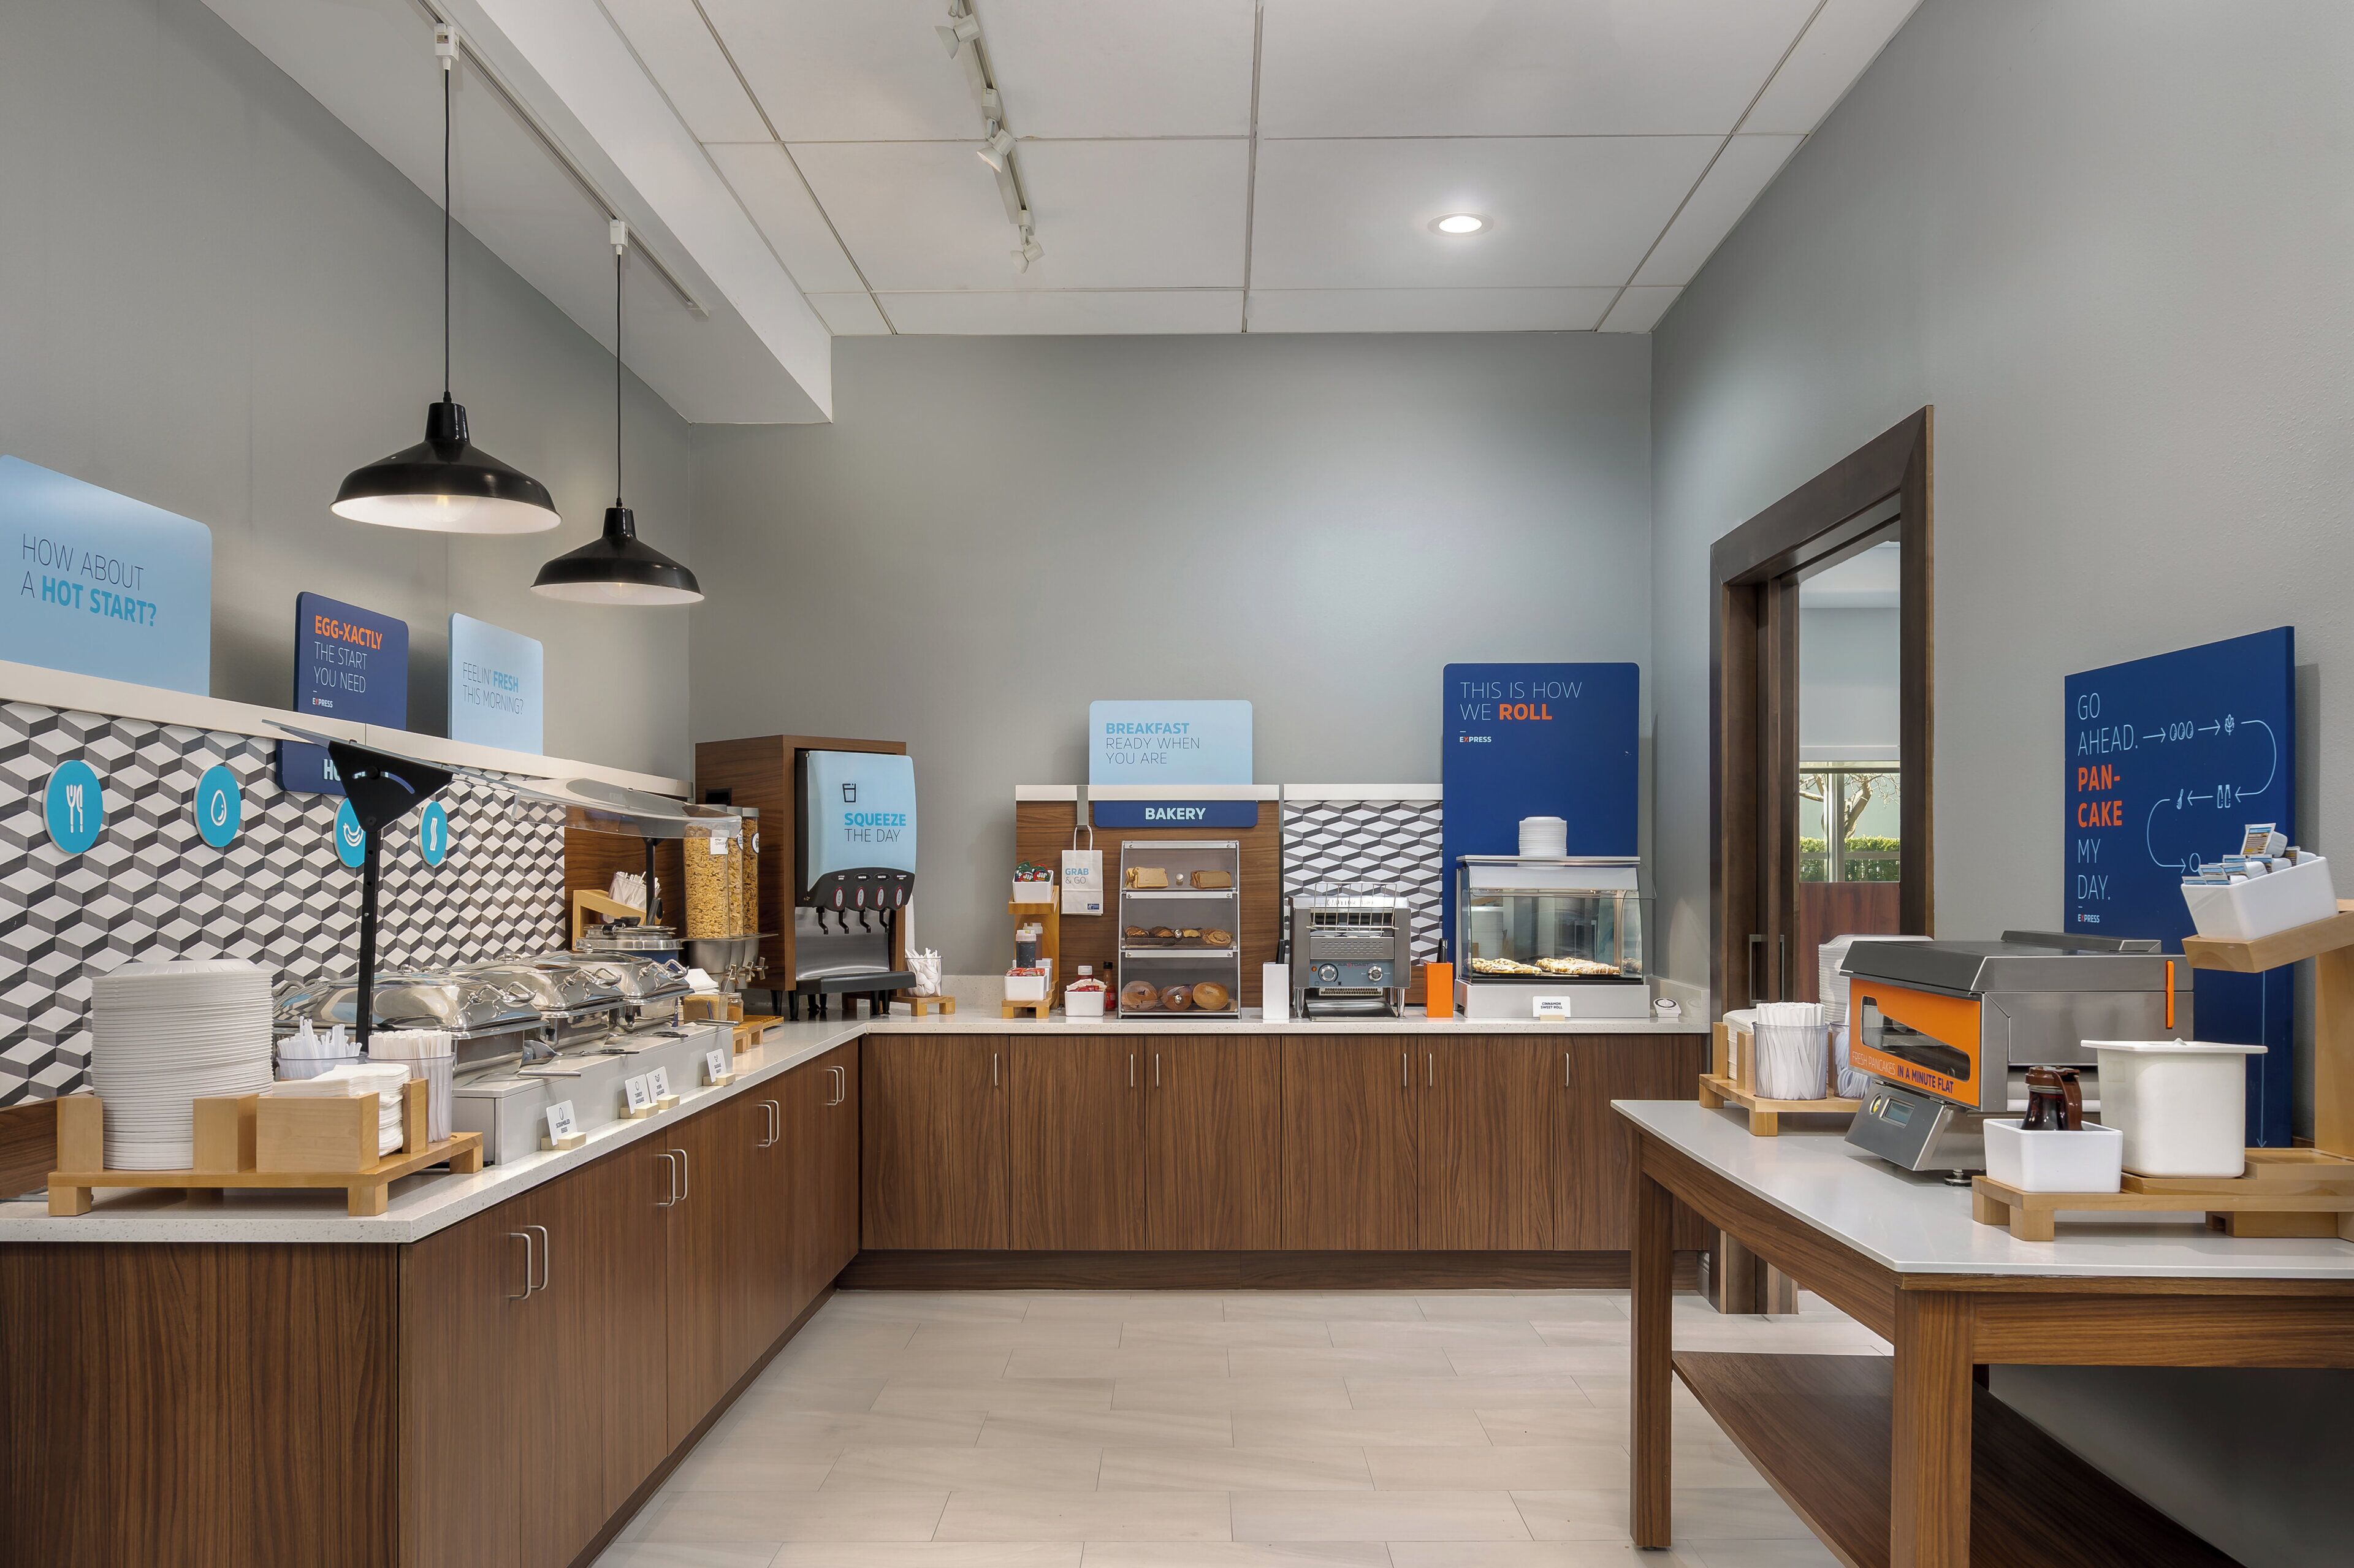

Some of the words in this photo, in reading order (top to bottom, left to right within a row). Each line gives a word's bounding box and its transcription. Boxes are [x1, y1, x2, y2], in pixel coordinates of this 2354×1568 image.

[23, 533, 73, 572] HOW
[80, 552, 144, 591] ABOUT
[21, 571, 35, 598] A
[42, 575, 83, 609] HOT
[90, 588, 157, 626] START?
[314, 615, 383, 650] EGG-XACTLY
[314, 641, 335, 663] THE
[338, 647, 368, 670] START
[313, 666, 337, 687] YOU
[340, 672, 366, 693] NEED
[463, 662, 491, 685] FEELIN'
[493, 671, 519, 693] FRESH
[1460, 682, 1502, 699] THIS
[1510, 682, 1525, 699] IS
[1533, 682, 1582, 699] HOW
[312, 697, 333, 708] EXPRESS
[462, 685, 480, 705] THIS
[483, 690, 524, 715] MORNING?
[1460, 704, 1491, 720] WE
[1499, 703, 1553, 720] ROLL
[2078, 693, 2100, 720] GO
[1106, 723, 1190, 734] BREAKFAST
[2078, 724, 2138, 756] AHEAD.
[1106, 737, 1152, 749] READY
[1157, 737, 1200, 749] WHEN
[1105, 753, 1135, 764] YOU
[1140, 753, 1167, 764] ARE
[2078, 764, 2121, 792] PAN-
[844, 812, 907, 827] SQUEEZE
[1145, 807, 1206, 820] BAKERY
[2078, 800, 2123, 828] CAKE
[844, 829, 871, 842] THE
[877, 829, 901, 842] DAY
[2078, 839, 2101, 864] MY
[2078, 875, 2111, 900] DAY.
[2078, 913, 2100, 923] EXPRESS
[1852, 1051, 1867, 1065] FRESH
[1868, 1056, 1896, 1075] PANCAKES
[1897, 1065, 1904, 1078] IN
[1905, 1068, 1910, 1080] A
[1911, 1069, 1936, 1089] MINUTE
[1937, 1076, 1954, 1094] FLAT
